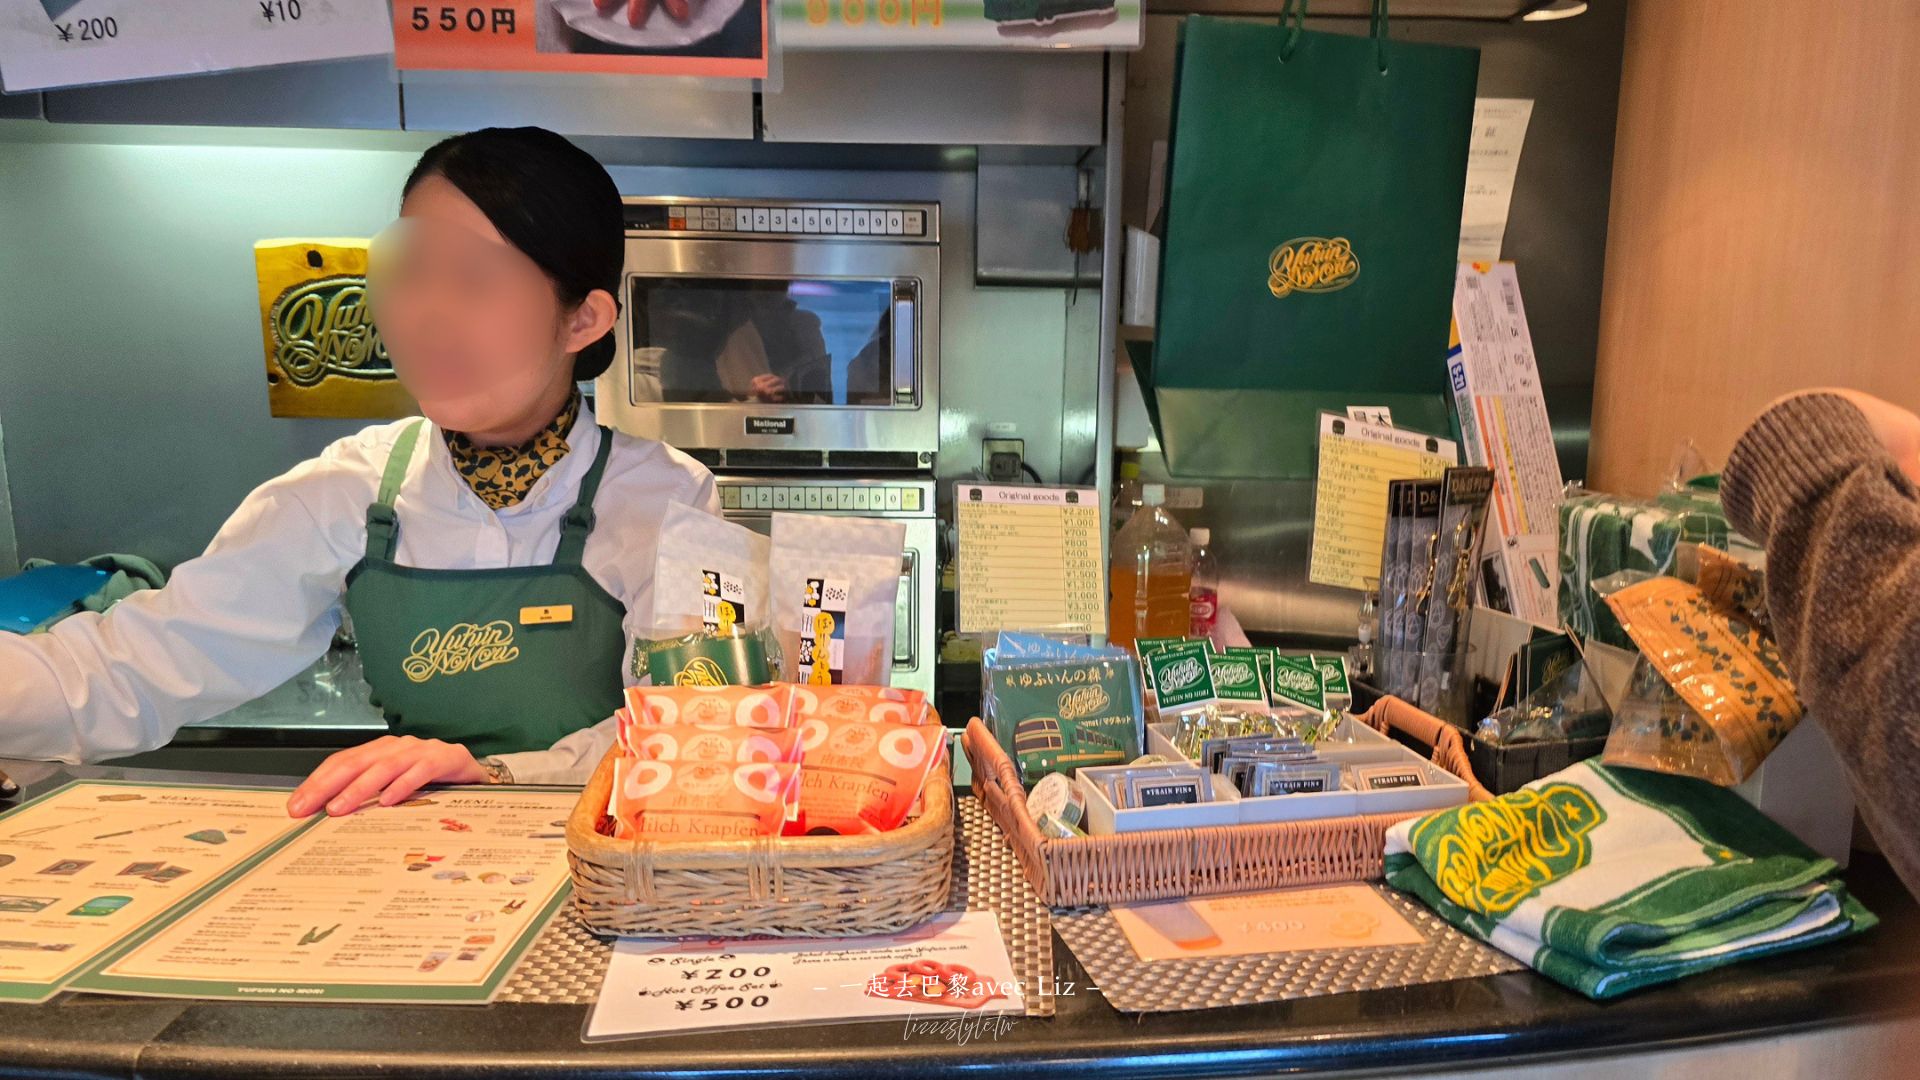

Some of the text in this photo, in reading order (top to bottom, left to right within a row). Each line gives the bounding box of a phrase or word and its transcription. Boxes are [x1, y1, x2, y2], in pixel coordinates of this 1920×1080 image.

[411, 7, 517, 34] 550円
[57, 17, 118, 42] ¥200
[753, 419, 786, 428] National
[1361, 427, 1393, 442] Original
[998, 491, 1060, 502] Original goods
[1020, 668, 1102, 688] ゆふいんの森
[829, 775, 889, 803] Krapfen
[688, 818, 760, 840] Krapfen
[670, 956, 715, 966] Single
[681, 966, 771, 980] ¥200
[691, 984, 735, 995] Coffee
[674, 995, 770, 1011] ¥500
